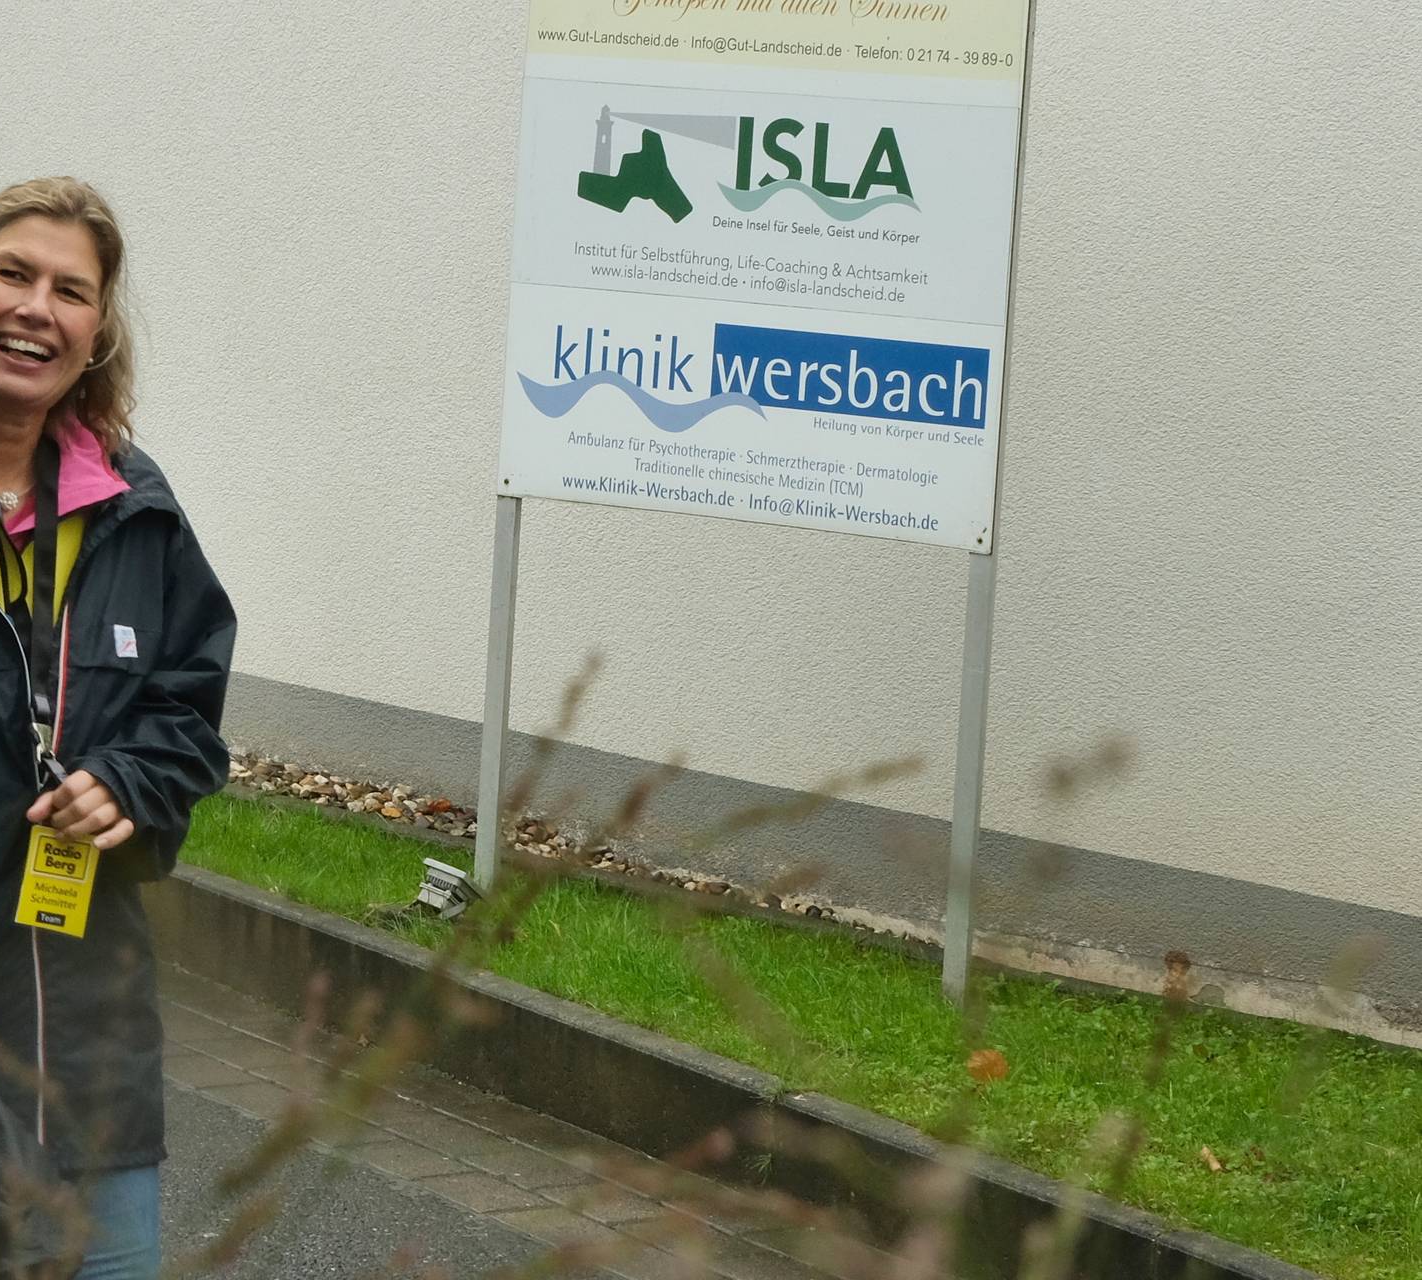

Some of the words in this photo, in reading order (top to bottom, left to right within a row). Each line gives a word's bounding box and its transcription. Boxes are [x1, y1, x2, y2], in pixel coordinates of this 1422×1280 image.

[537, 29, 679, 48] www.Gut-Landscheid.de
[691, 36, 842, 57] Info@Gut-Landscheid.de
[855, 45, 902, 61] Telefon:
[736, 116, 914, 200] ISLA
[713, 216, 743, 229] Deine
[747, 219, 770, 231] Insel
[773, 220, 788, 233] für
[791, 222, 823, 237] Seele,
[827, 226, 854, 239] Geist
[858, 229, 879, 240] und
[882, 231, 920, 246] Körper
[574, 242, 617, 258] Institut
[621, 244, 638, 259] für
[641, 247, 733, 271] Selbstführung,
[737, 255, 828, 280] Life-Coaching
[832, 263, 842, 277] &
[846, 264, 929, 285] Achtsamkeit
[591, 265, 738, 288] www.isla-landscheid.de
[750, 275, 905, 303] info@isla-landscheid.de
[553, 325, 694, 393] klinik
[715, 349, 985, 420] wersbach
[813, 417, 857, 435] Heilung
[861, 424, 882, 436] von
[885, 424, 924, 442] Körper
[928, 431, 950, 443] und
[954, 432, 984, 446] Seele
[567, 431, 624, 449] Ambulanz
[628, 437, 645, 451] für
[649, 440, 736, 464] Psychotherapie
[746, 450, 846, 475] Schmerztherapie
[856, 463, 939, 487] Dermatologie
[634, 457, 705, 479] Traditionelle
[708, 467, 775, 487] chinesische
[778, 474, 825, 493] Medizin
[829, 480, 864, 498] (TCM)
[562, 476, 735, 506] www.Klinik-Wersbach.de
[749, 494, 939, 531] Info@Klinik-Wersbach.de
[43, 843, 82, 860] Radio
[45, 856, 76, 875] Berg
[34, 882, 78, 898] Michaela
[40, 912, 62, 925] Team
